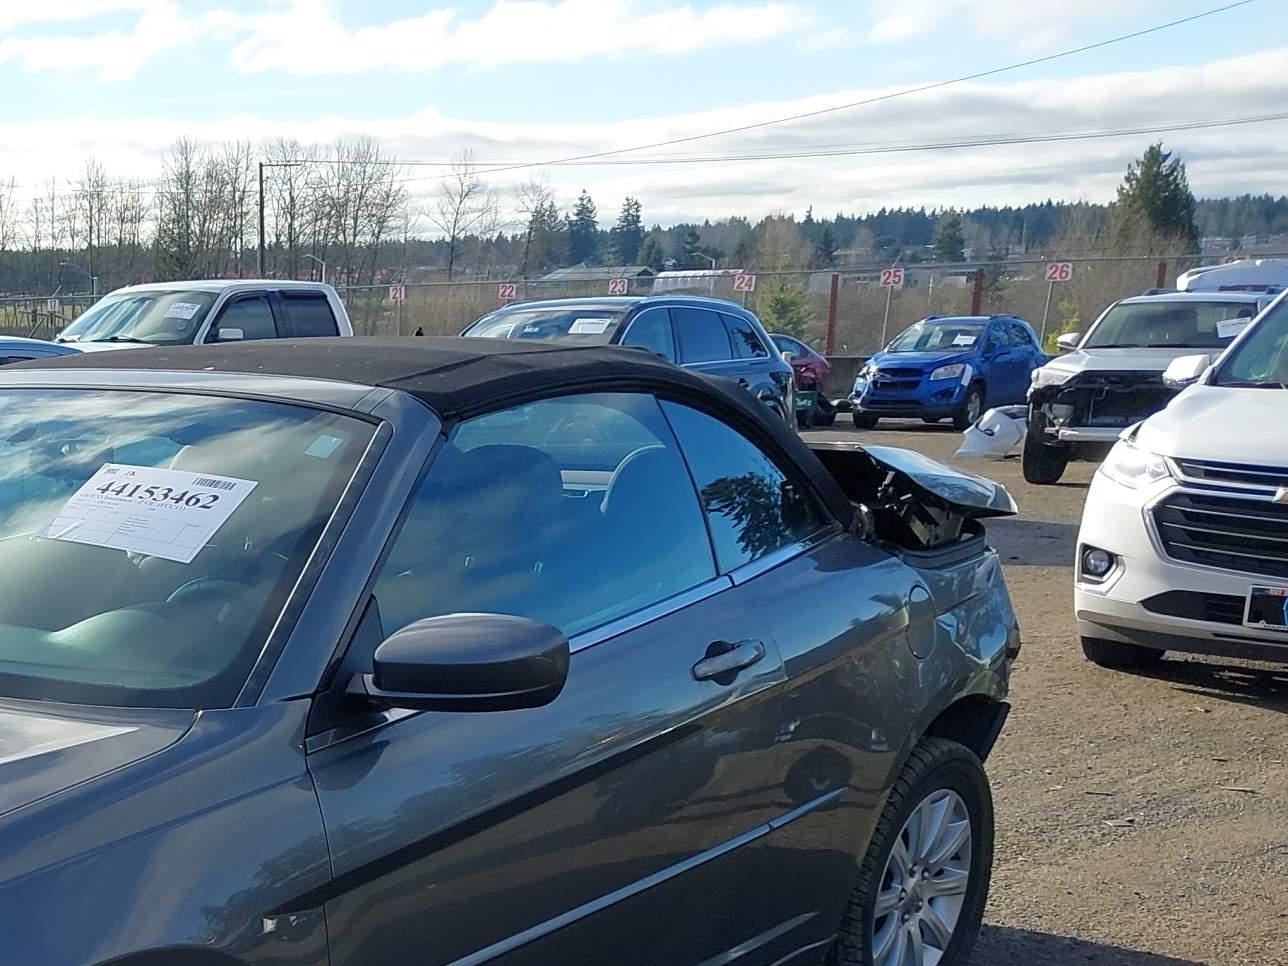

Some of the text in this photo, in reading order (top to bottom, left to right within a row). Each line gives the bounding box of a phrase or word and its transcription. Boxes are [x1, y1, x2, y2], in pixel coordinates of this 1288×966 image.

[882, 270, 902, 285] 25
[1048, 264, 1070, 280] 26
[610, 280, 626, 293] 23
[735, 276, 753, 290] 24
[392, 287, 403, 299] 21
[500, 285, 514, 298] 22
[95, 480, 220, 510] 44153462
